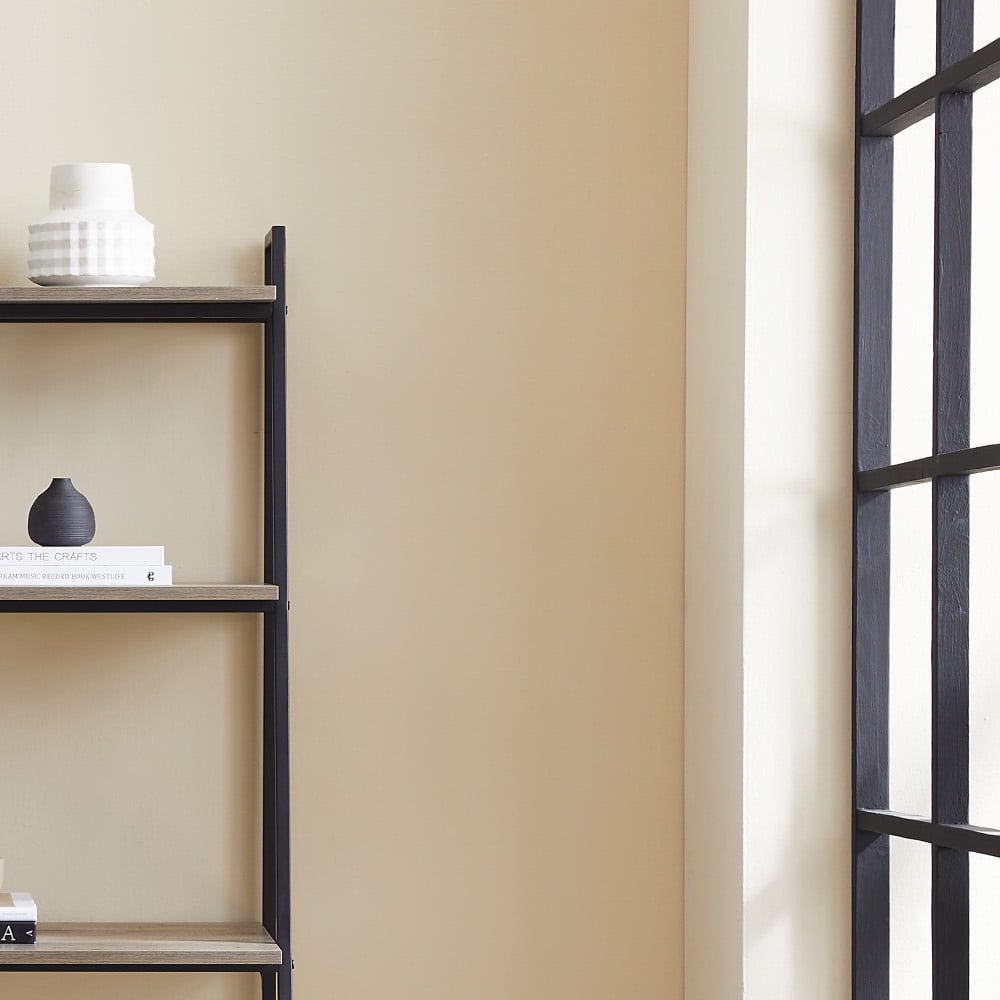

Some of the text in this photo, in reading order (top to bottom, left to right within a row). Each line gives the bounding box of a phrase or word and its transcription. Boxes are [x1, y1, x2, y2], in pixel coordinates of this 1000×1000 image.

[28, 552, 49, 561] THE
[55, 552, 98, 561] CRAFTS
[20, 572, 41, 580] MUSIC
[42, 572, 70, 580] RECORD
[71, 572, 90, 580] BOOK
[91, 572, 126, 580] WESTLIFE
